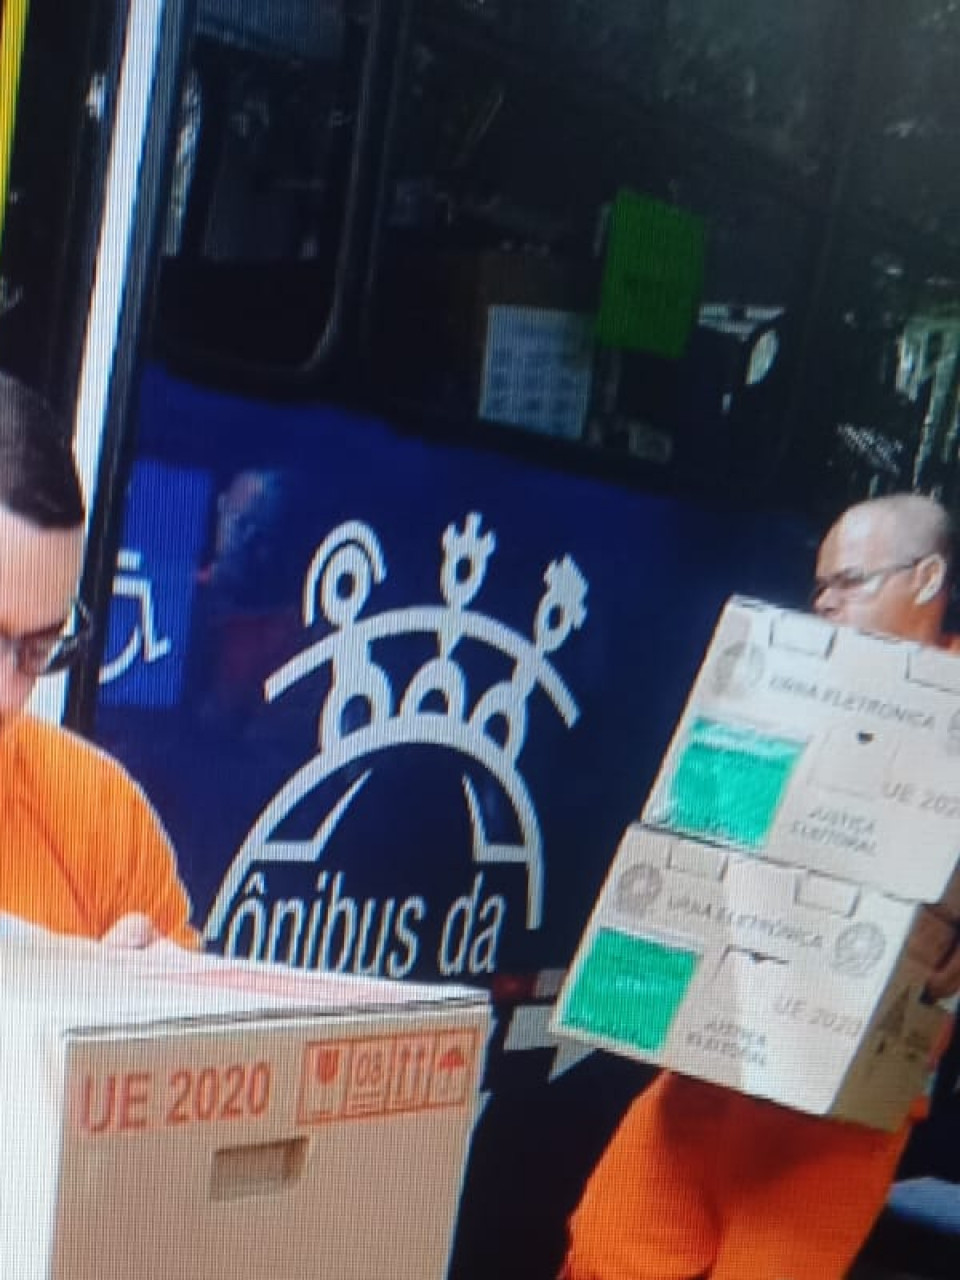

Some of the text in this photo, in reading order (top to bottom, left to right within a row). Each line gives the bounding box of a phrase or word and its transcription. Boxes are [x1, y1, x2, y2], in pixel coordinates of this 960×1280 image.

[224, 870, 507, 979] ônibus da
[80, 1061, 273, 1134] UE 2020
